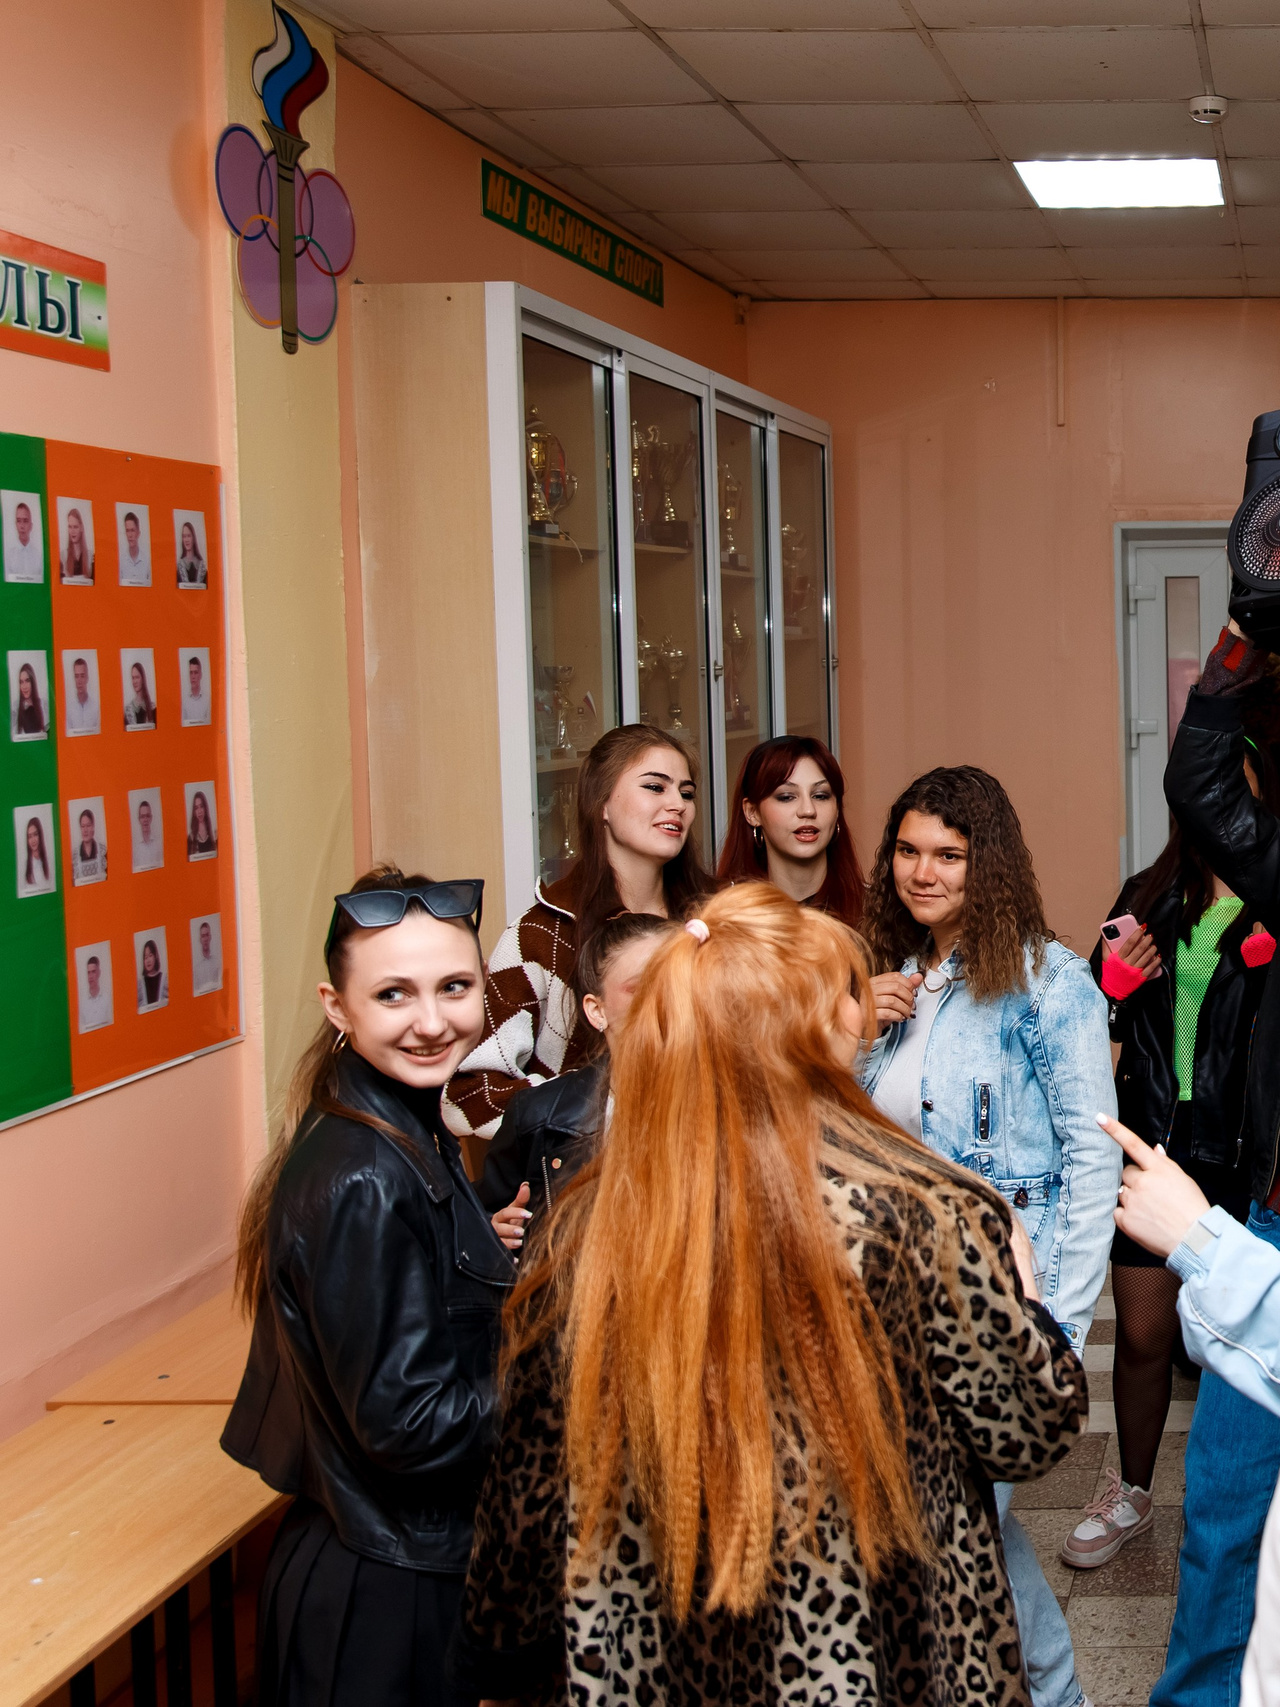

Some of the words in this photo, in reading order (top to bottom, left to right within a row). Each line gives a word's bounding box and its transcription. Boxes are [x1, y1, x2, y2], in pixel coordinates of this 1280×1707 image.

[486, 170, 522, 224] МЫ
[525, 192, 612, 272] ВЫБИРАЕМ
[614, 243, 663, 299] СПОРТ!
